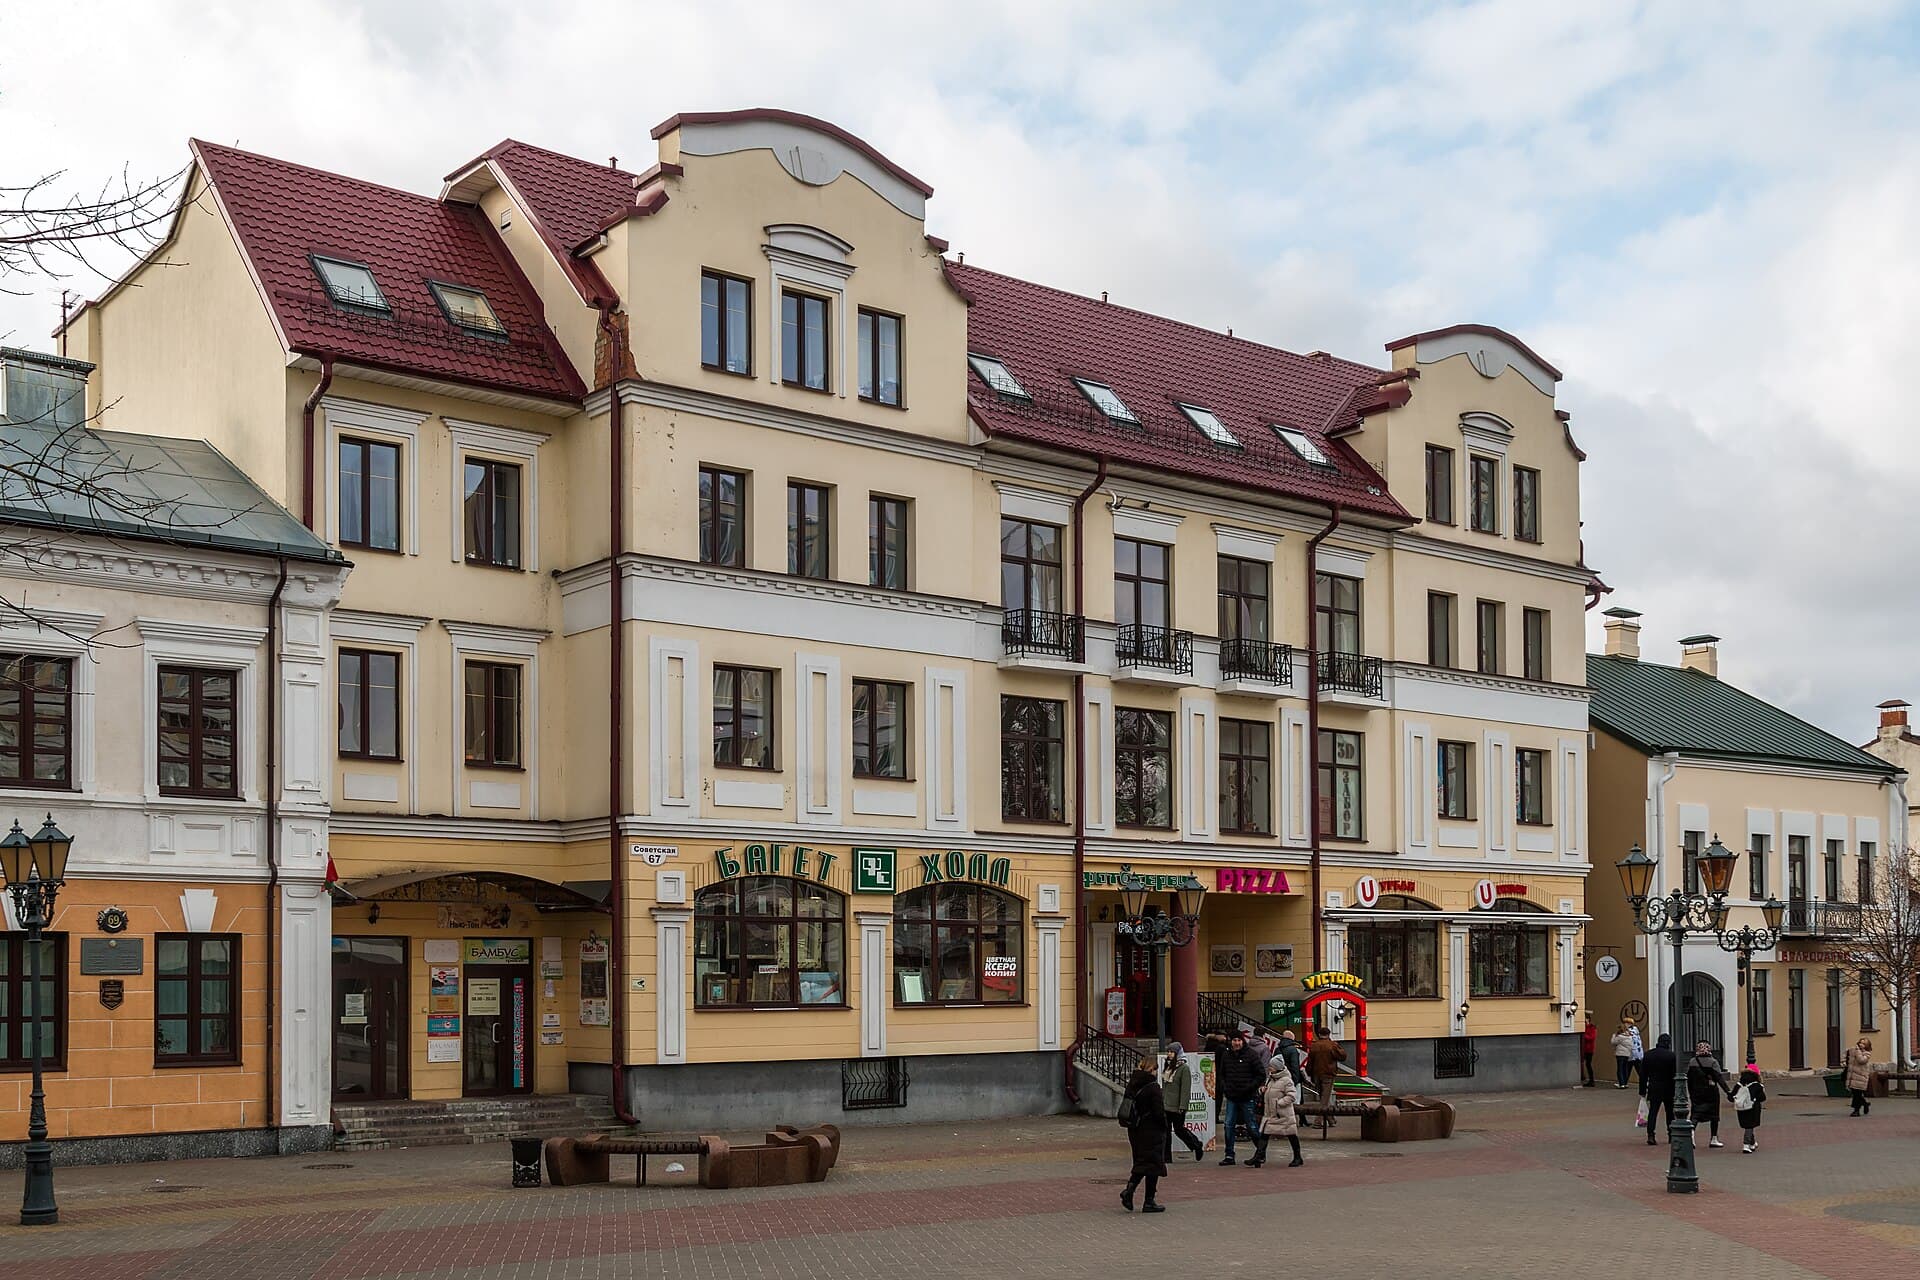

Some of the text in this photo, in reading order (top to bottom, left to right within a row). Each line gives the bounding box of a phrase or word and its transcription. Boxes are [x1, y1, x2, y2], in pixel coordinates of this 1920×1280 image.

[1338, 742, 1355, 760] 3D
[634, 845, 676, 855] Советская
[648, 854, 661, 864] 67
[714, 843, 839, 881] БАГЕТ
[919, 850, 1012, 886] ХОЛЛ
[1216, 868, 1290, 894] PIZZA
[1361, 879, 1375, 902] U
[1480, 883, 1492, 904] U
[107, 914, 120, 925] 69
[471, 947, 519, 959] БАМБУС
[985, 963, 1017, 971] КСЕРО
[1304, 972, 1363, 990] VICTORY
[1186, 1122, 1208, 1132] BAN
